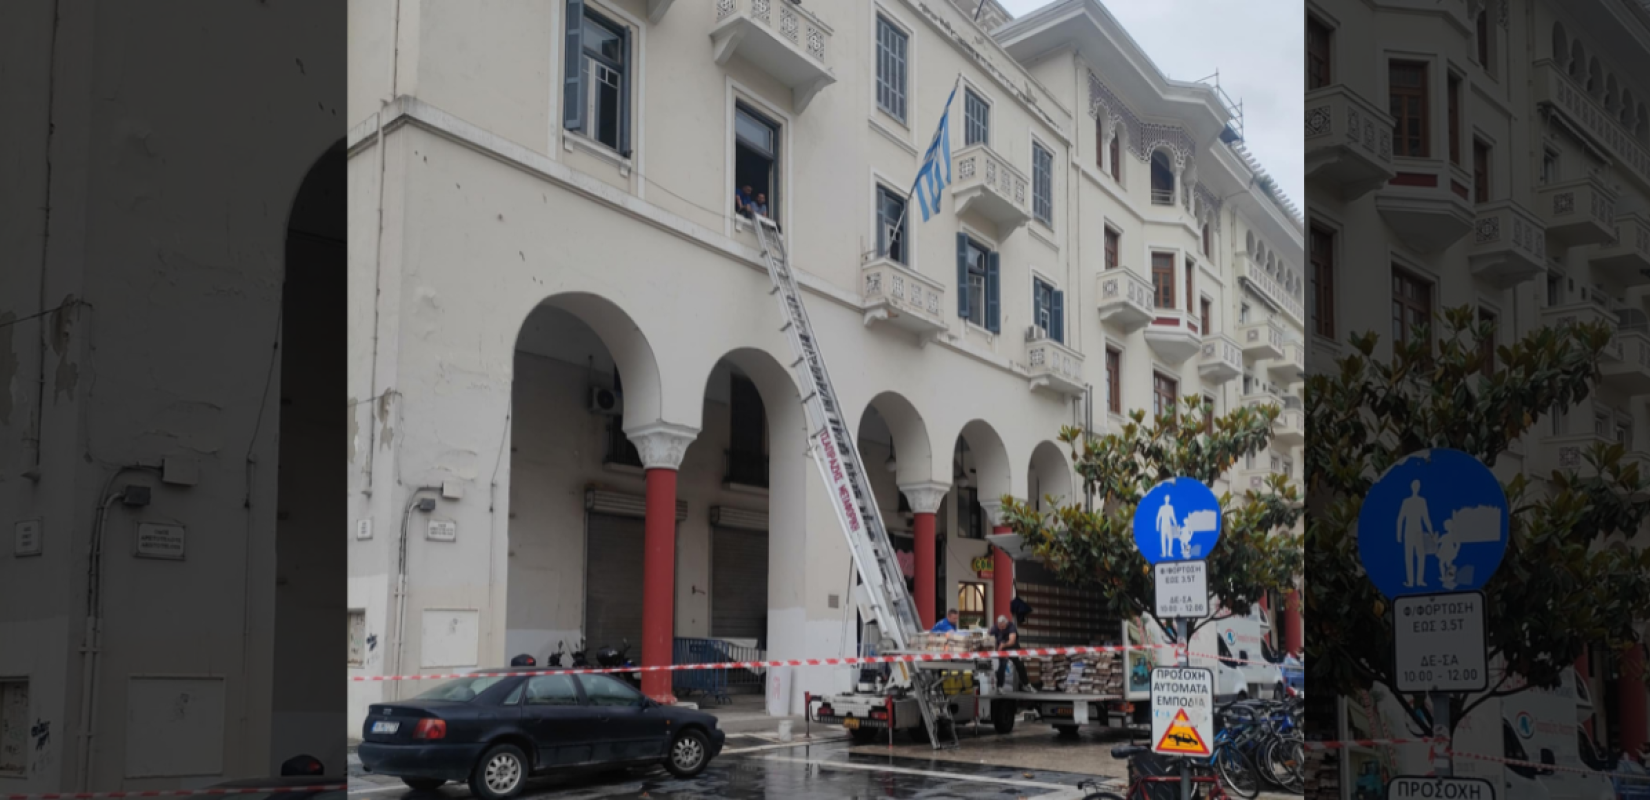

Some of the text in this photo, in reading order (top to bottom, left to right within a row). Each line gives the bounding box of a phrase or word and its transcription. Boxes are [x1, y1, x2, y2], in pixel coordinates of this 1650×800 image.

[1403, 602, 1474, 618] Φ/ΦΟΡΤΩΣΗ
[1412, 620, 1437, 633] ΕΩΣ
[1420, 654, 1459, 667] ΔΕ-ΣΑ
[1157, 669, 1206, 681] ΠΡΟΣΟΧΗ
[1404, 670, 1433, 682] 10:00
[1448, 668, 1478, 681] 12:00
[1153, 682, 1208, 694] ΑΥΤΟΜΑΤΑ
[1157, 695, 1206, 708] ΕΜΠΟΔΙΑ
[1397, 780, 1481, 800] ΠΡΟΣΟΧΗ
